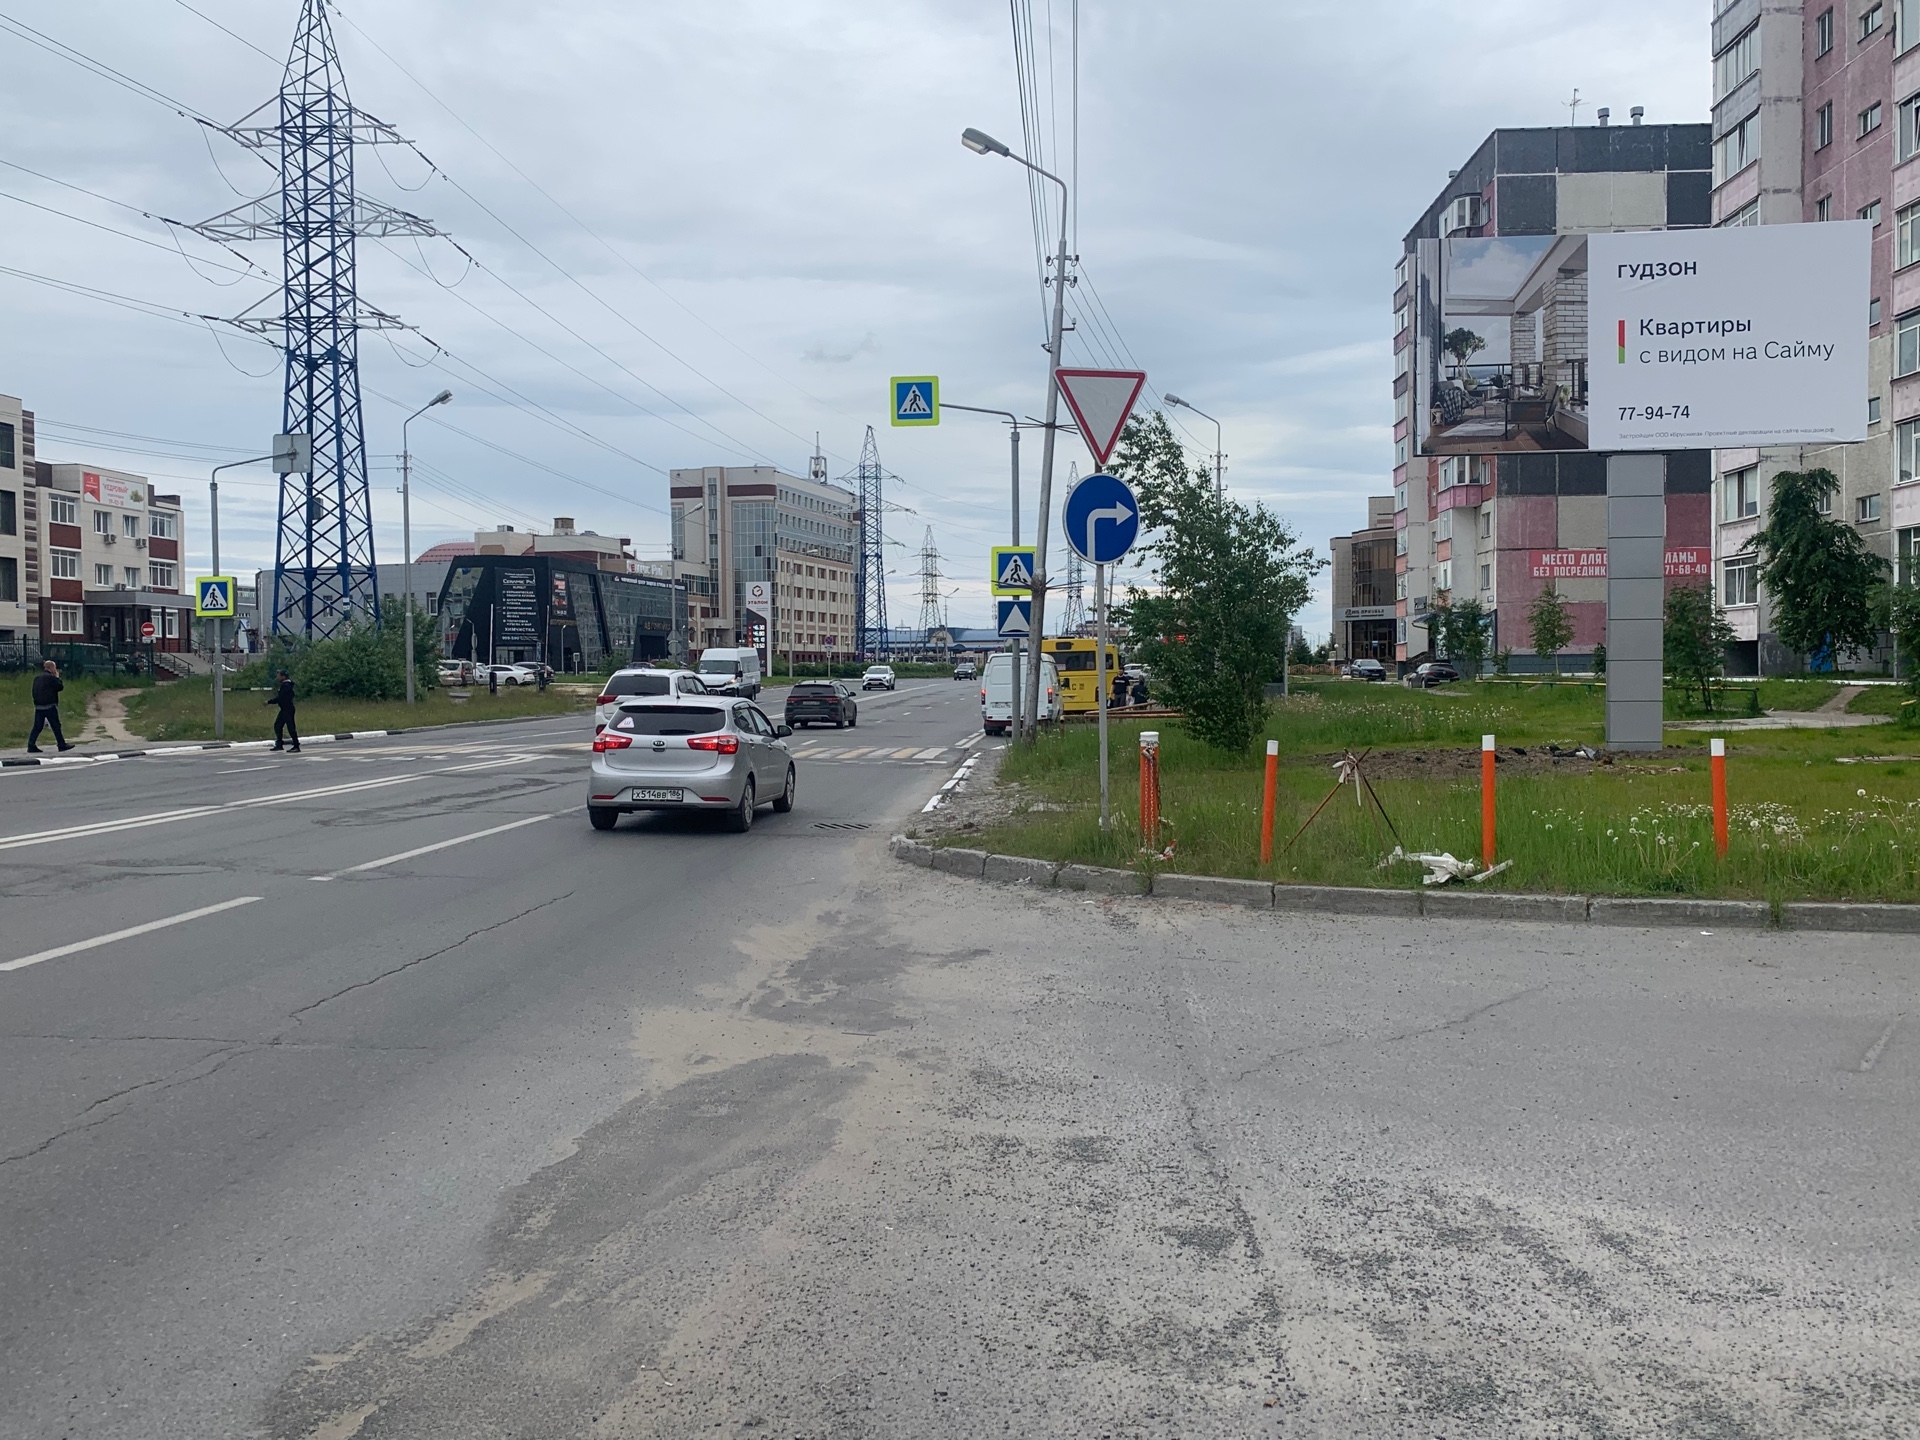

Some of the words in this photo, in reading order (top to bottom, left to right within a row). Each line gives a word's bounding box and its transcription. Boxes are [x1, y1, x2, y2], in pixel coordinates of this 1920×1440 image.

[1618, 261, 1697, 280] ГУДЗОН
[1640, 318, 1751, 338] Квартиры
[1640, 350, 1652, 364] с
[1658, 347, 1725, 366] видом
[1732, 344, 1758, 361] на
[1764, 341, 1834, 362] Сайму
[1618, 406, 1690, 420] 77-94-74
[1542, 554, 1574, 565] МЕСТО
[1580, 553, 1603, 565] ДЛЯ
[1534, 566, 1549, 576] БЕЗ
[1553, 565, 1607, 577] ПОСРЕДНИК
